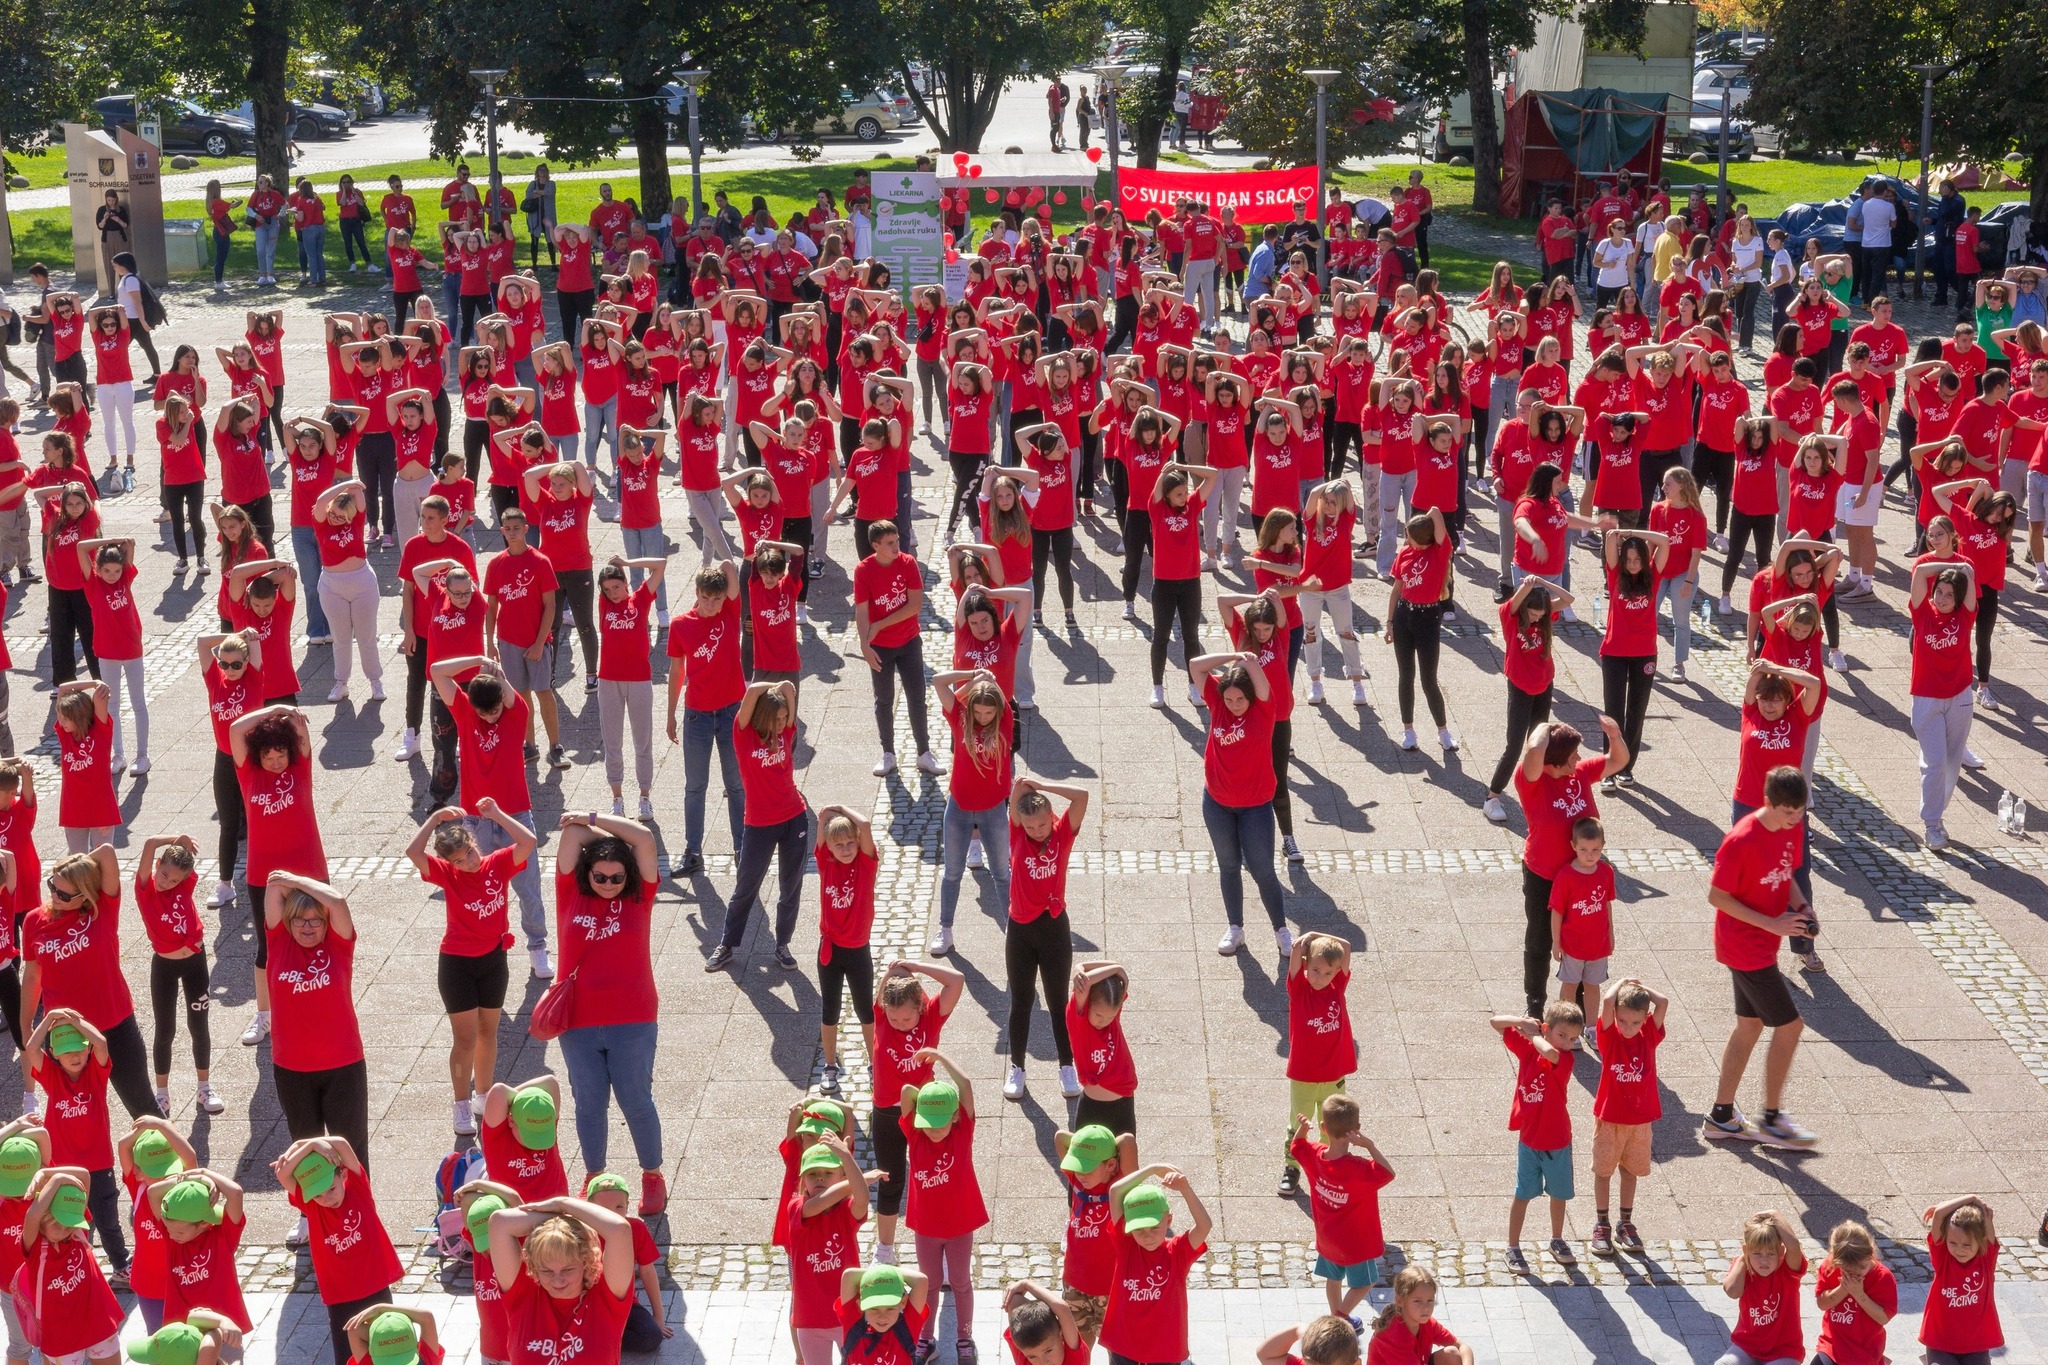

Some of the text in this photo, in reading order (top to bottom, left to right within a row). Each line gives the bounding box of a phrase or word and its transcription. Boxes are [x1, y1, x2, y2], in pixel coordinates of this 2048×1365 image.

[1140, 187, 1296, 207] SVJETSKI DAN SRCA
[889, 219, 921, 227] Zdravlje
[878, 227, 915, 235] nadohvat
[1969, 533, 1984, 543] #BE
[761, 609, 776, 619] #BE
[965, 650, 981, 659] #BE
[1750, 730, 1770, 741] #BE
[752, 748, 769, 759] #BE
[251, 794, 272, 805] #BE
[1572, 900, 1587, 910] #BE
[573, 915, 596, 928] #BE
[38, 939, 60, 955] #BE
[278, 970, 305, 984] #BE
[1307, 1017, 1324, 1028] #BE
[55, 1099, 70, 1110] #BE
[1941, 1288, 1957, 1299] #BE
